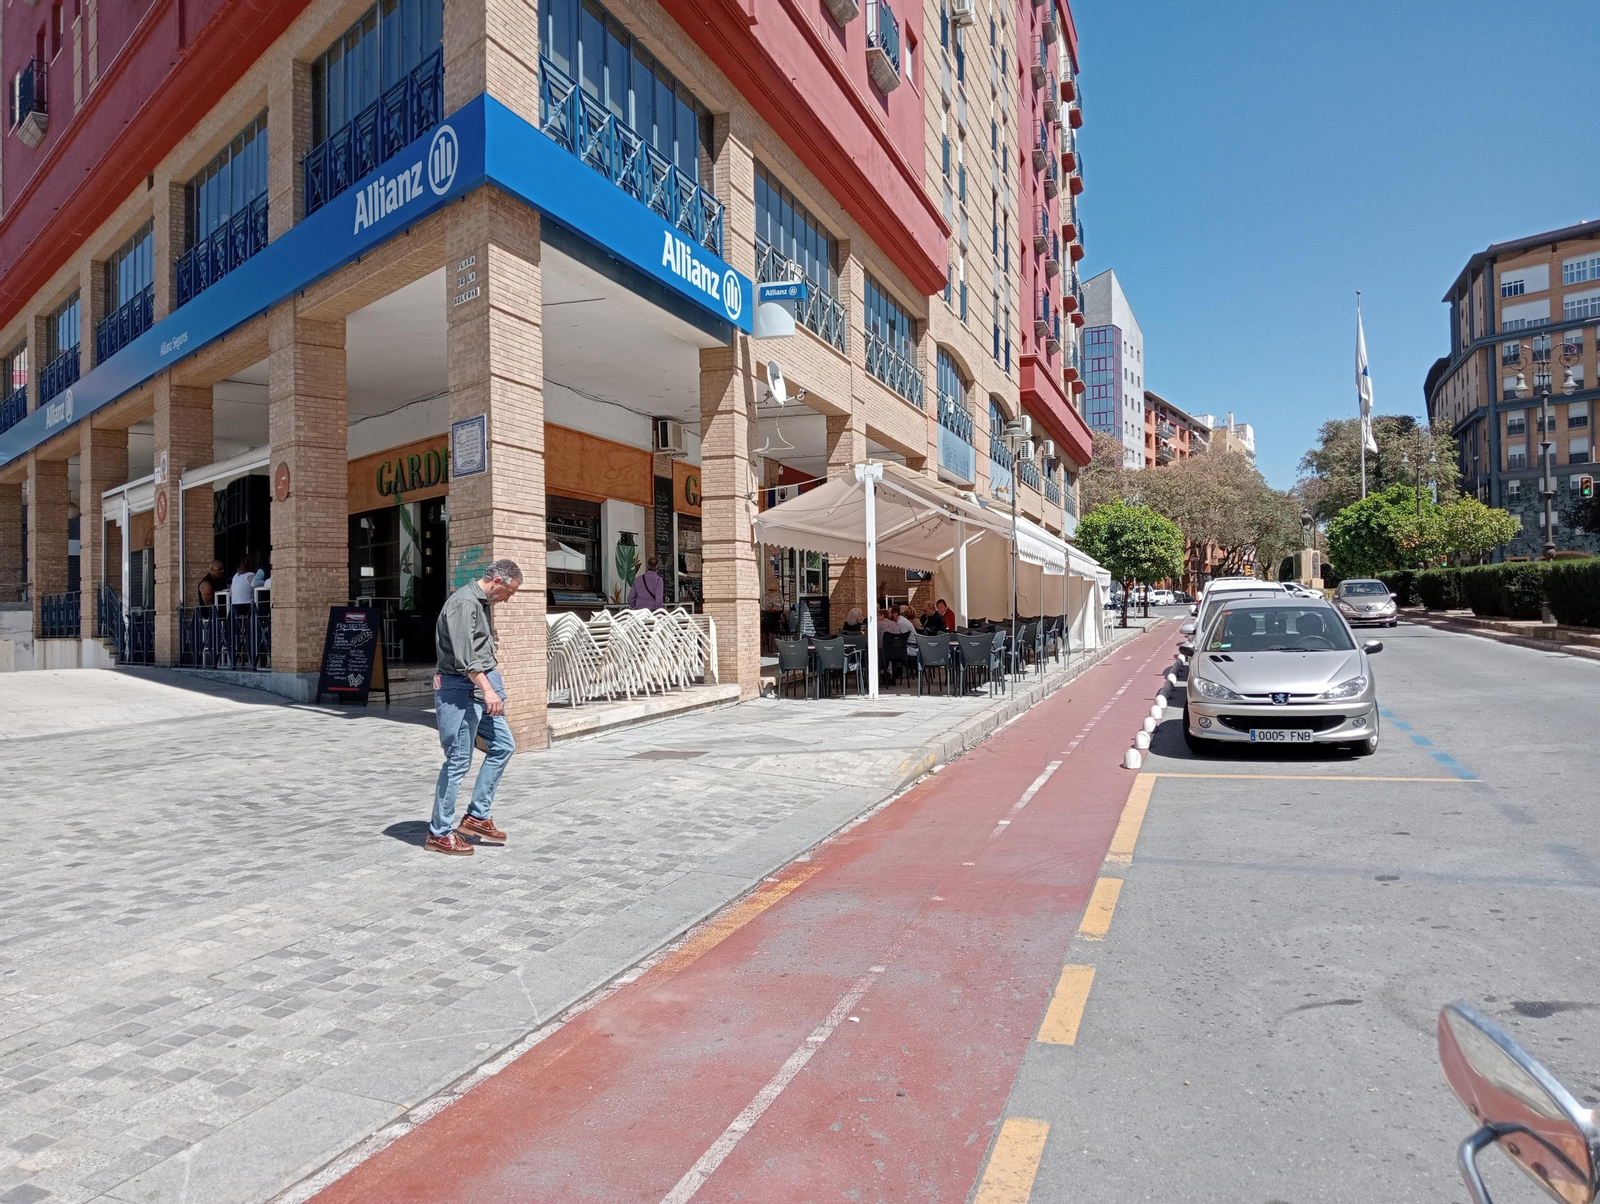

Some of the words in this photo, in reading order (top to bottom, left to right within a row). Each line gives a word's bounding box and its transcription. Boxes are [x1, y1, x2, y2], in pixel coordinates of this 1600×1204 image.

[354, 160, 423, 235] Allianz
[661, 230, 720, 300] Allianz
[468, 272, 476, 283] LA
[454, 288, 480, 305] SOLEDAD
[160, 341, 172, 356] Allianz
[46, 402, 65, 429] Allianz
[1258, 731, 1285, 741] 0005
[1290, 731, 1311, 741] FNB
